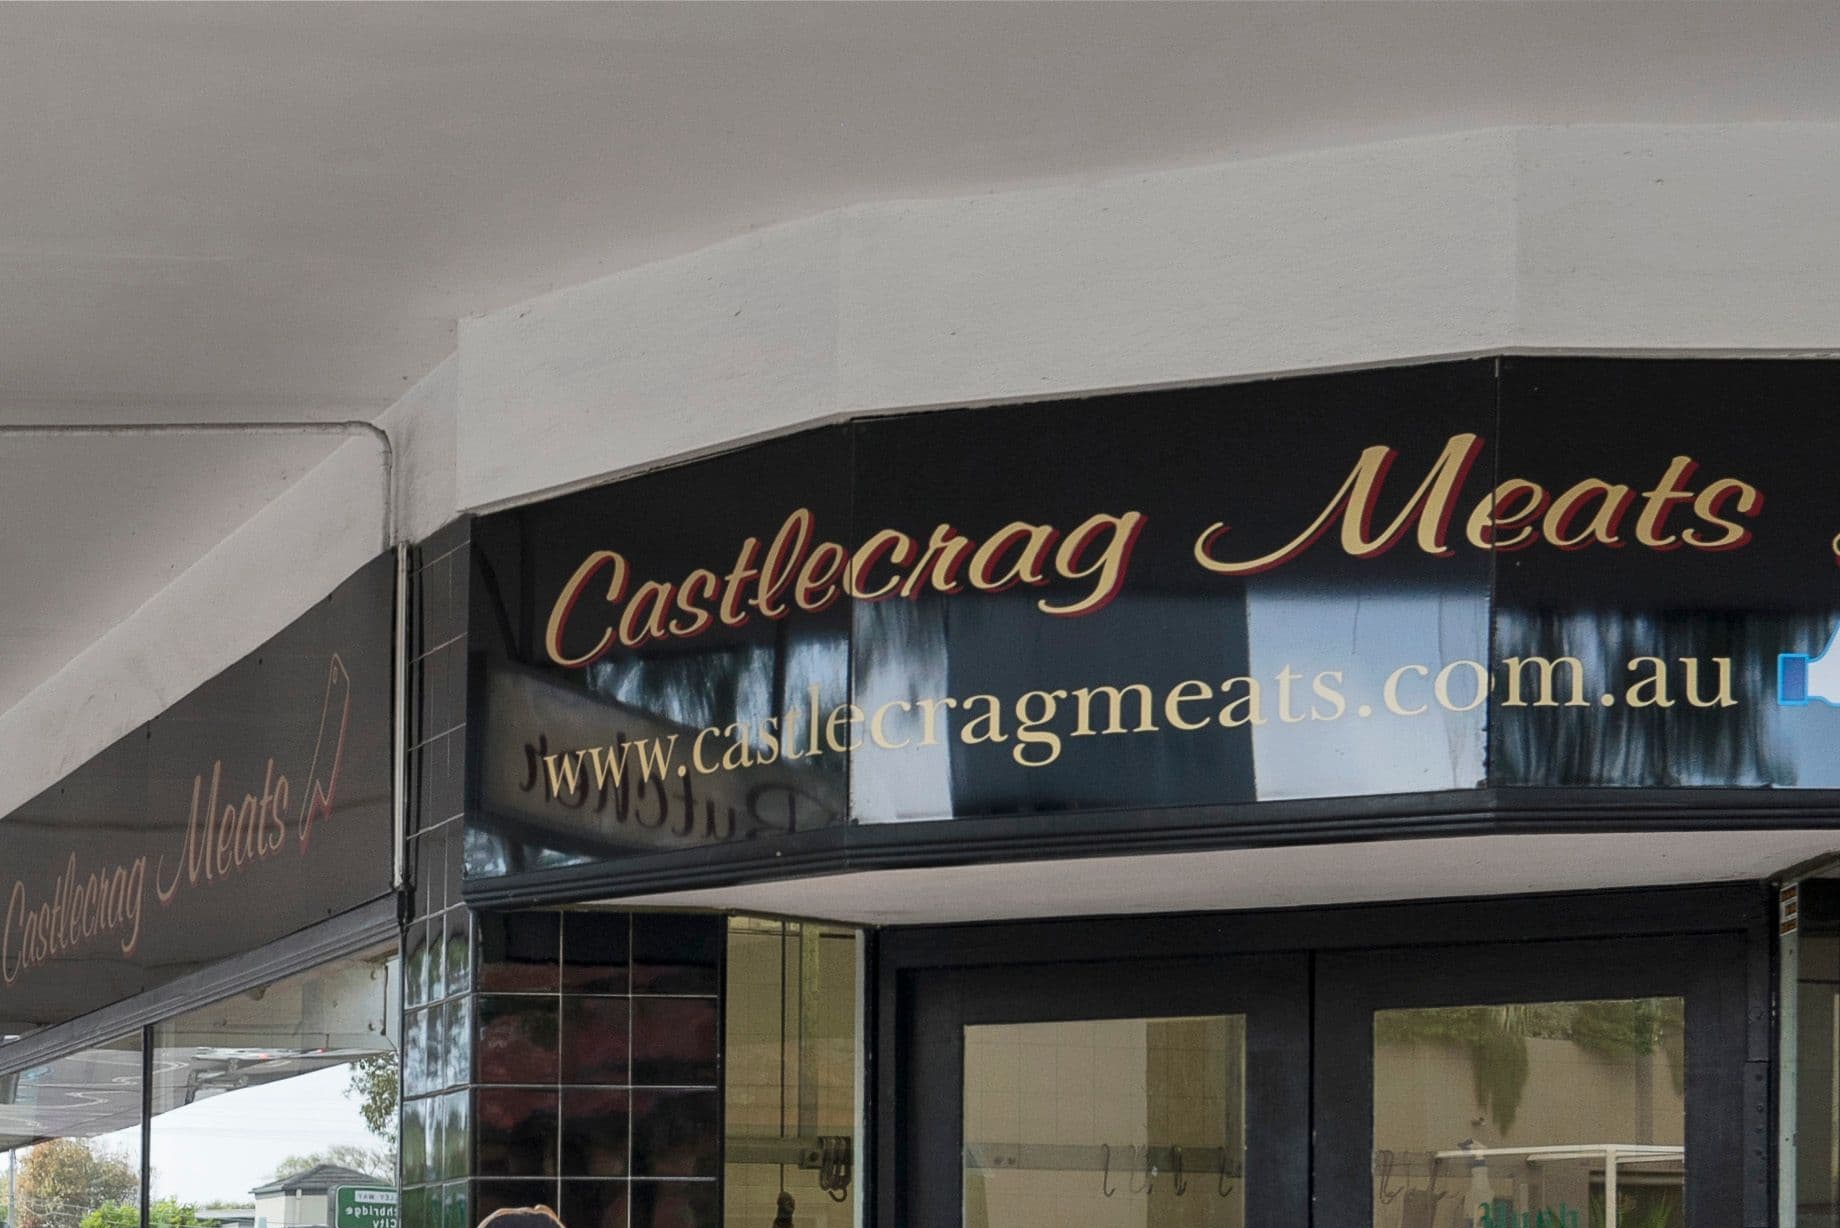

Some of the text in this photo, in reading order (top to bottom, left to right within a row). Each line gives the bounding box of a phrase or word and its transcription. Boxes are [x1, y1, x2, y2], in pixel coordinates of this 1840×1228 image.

[545, 432, 1764, 669] Castlecrag Meats
[545, 652, 1738, 799] www.castlecragmeats.com.au
[1, 757, 291, 985] Castlecrag Meats
